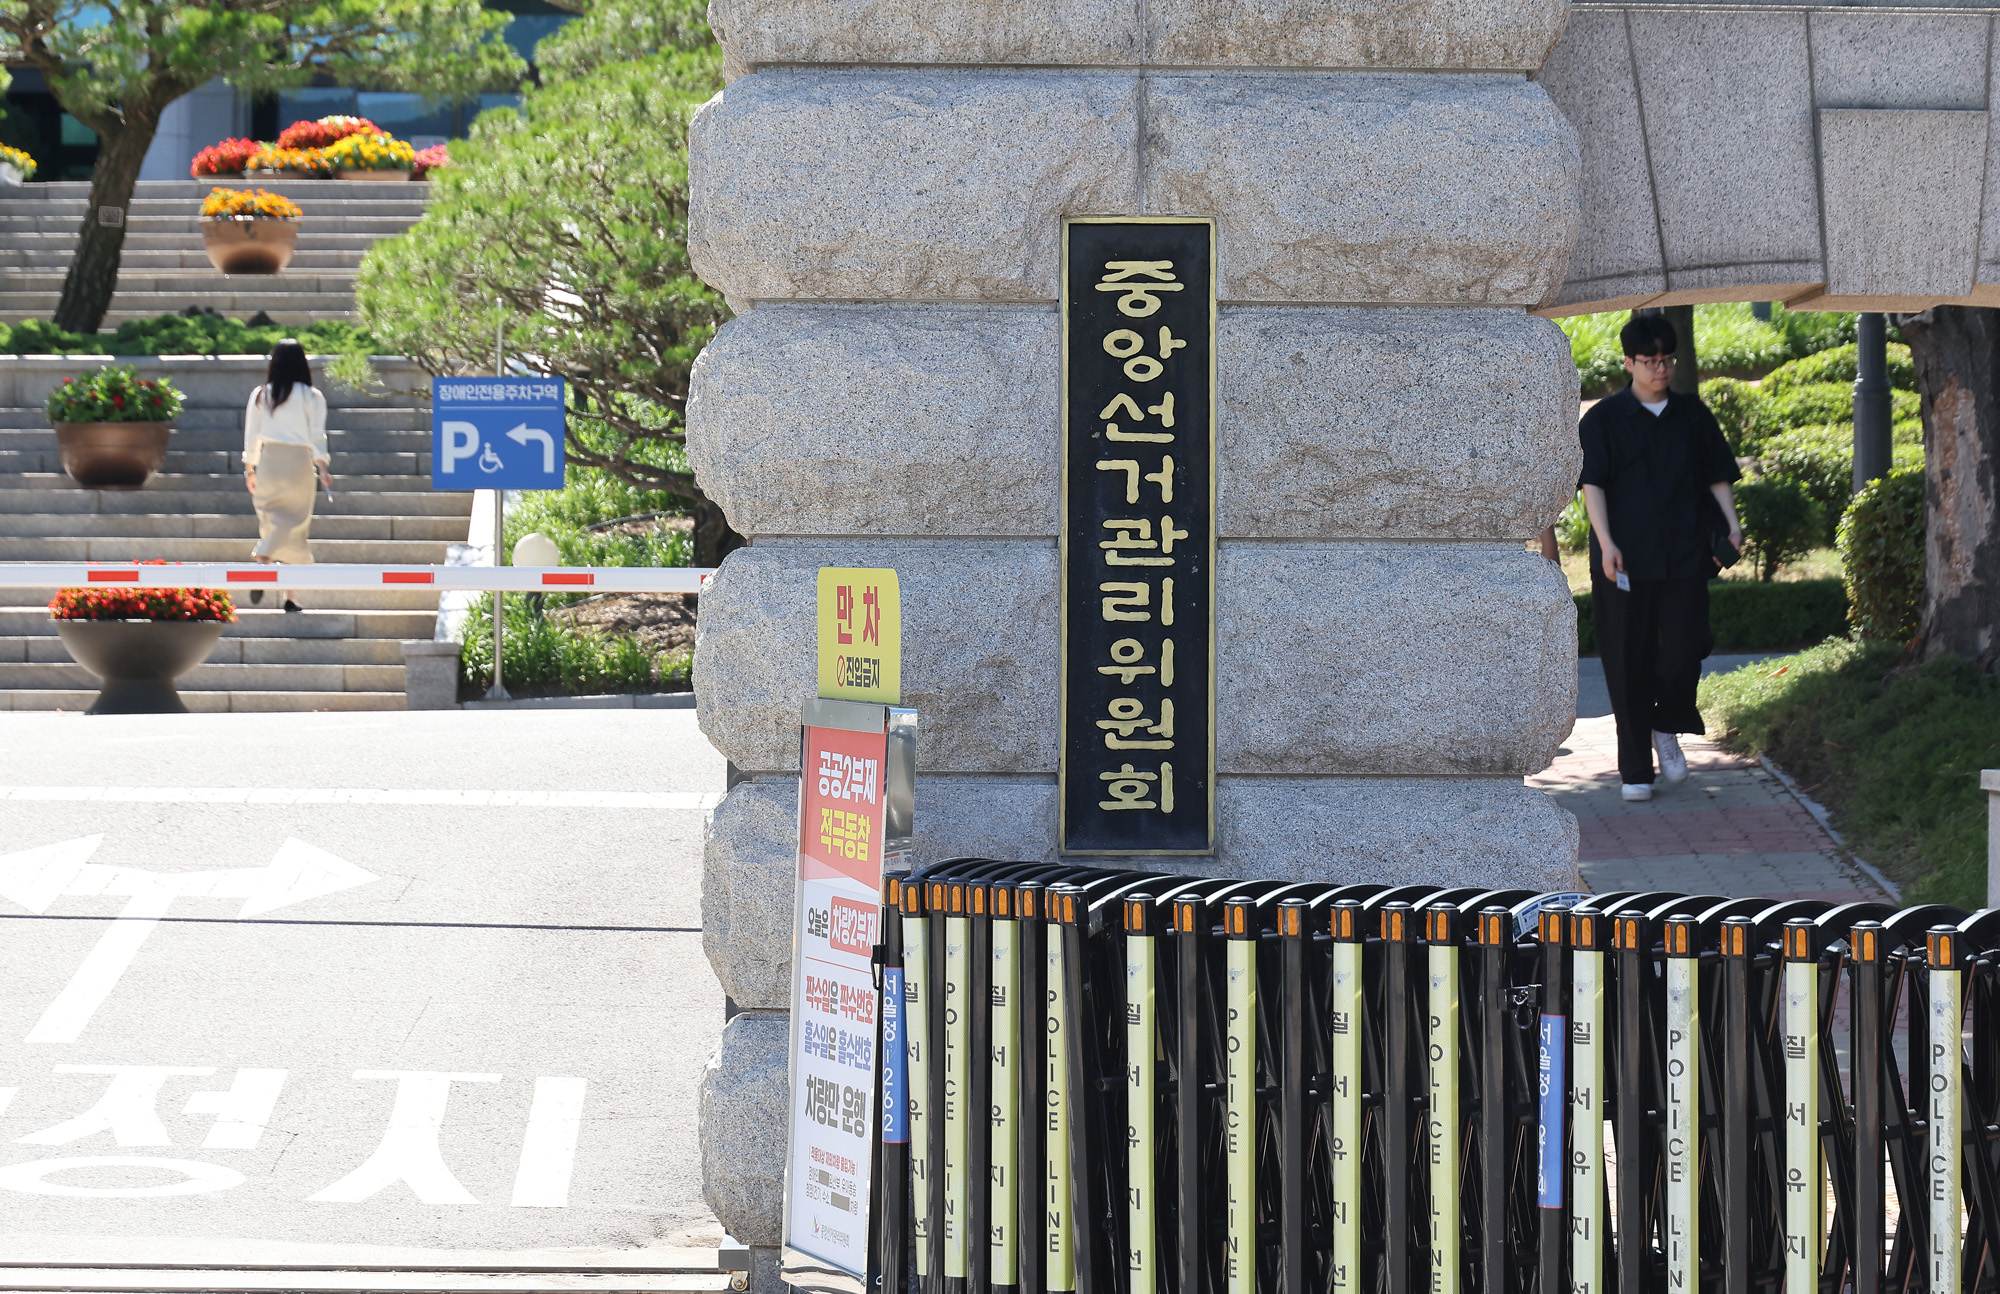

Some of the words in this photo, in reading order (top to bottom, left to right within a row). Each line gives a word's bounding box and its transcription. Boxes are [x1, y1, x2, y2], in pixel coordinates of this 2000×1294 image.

[439, 384, 558, 401] 장애인전용주차구역
[442, 421, 479, 474] P
[1095, 259, 1188, 814] 중앙선거관리위원회
[846, 656, 880, 689] 진입금지
[818, 750, 878, 805] 공공2부제
[820, 808, 870, 861] 적극동참
[808, 907, 829, 938] 오늘은
[831, 905, 877, 950] 차량2부제
[806, 975, 838, 1015] 짝수일은
[840, 984, 874, 1025] 짝수번호
[805, 1020, 836, 1061] 홀수일은
[838, 1029, 872, 1072] 홀수번호
[884, 974, 897, 1132] 서울청-262
[945, 982, 958, 1121] POLICE
[1047, 990, 1060, 1131] POLICE
[1227, 1008, 1240, 1153] POLICE
[1430, 1015, 1443, 1164] POLICE
[0, 1064, 588, 1207] 정지
[805, 1074, 840, 1128] 차량만
[842, 1085, 866, 1138] 운행
[1668, 1029, 1684, 1183] POLICE
[1931, 1043, 1948, 1201] POLICE
[945, 1149, 954, 1239] LINE
[1048, 1160, 1060, 1252] LINE
[1227, 1183, 1238, 1278] LINE
[1431, 1195, 1442, 1292] LINE
[1669, 1214, 1683, 1294] LIN
[1932, 1233, 1945, 1294] LI
